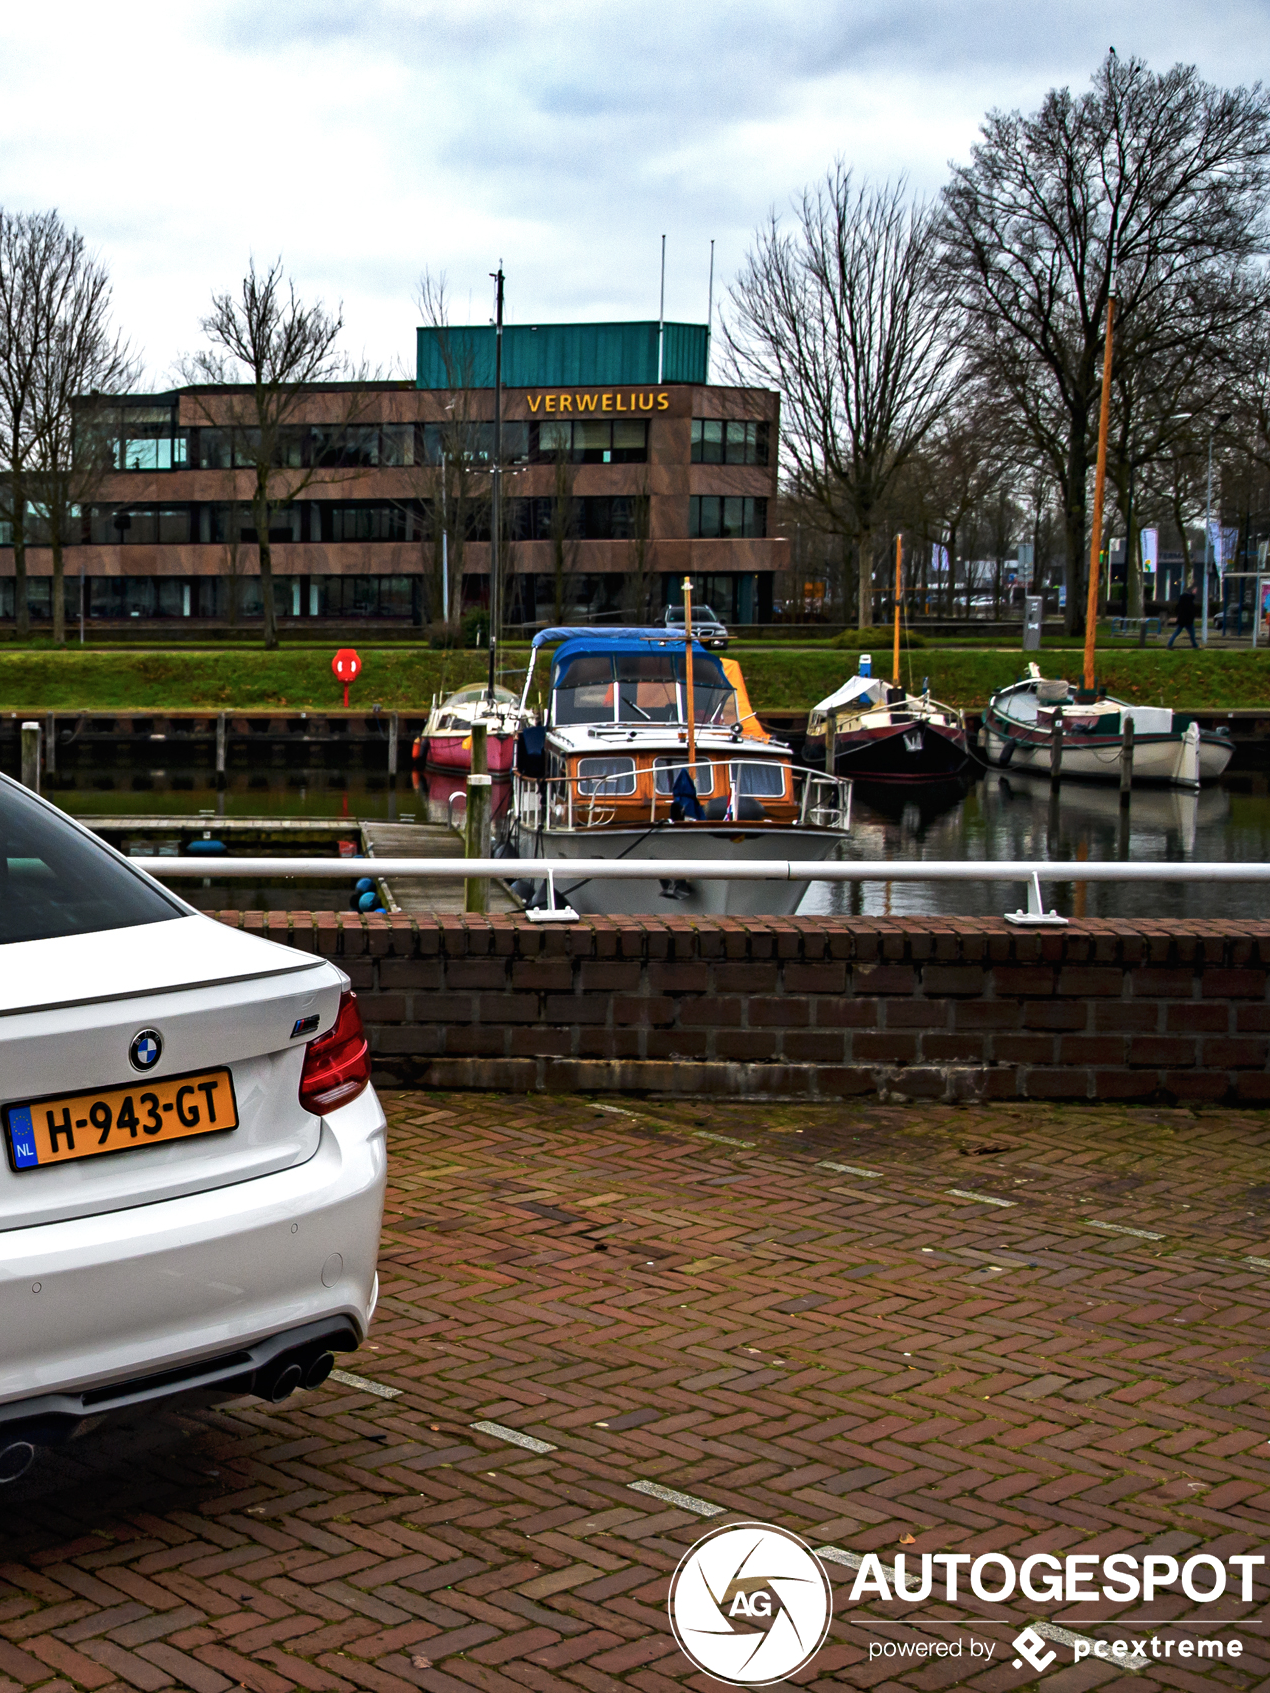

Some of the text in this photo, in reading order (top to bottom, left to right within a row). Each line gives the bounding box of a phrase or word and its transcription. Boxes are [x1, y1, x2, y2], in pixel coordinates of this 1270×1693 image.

[527, 393, 669, 412] VERWELIUS
[45, 1081, 218, 1153] H-943-GT
[16, 1143, 34, 1158] NL
